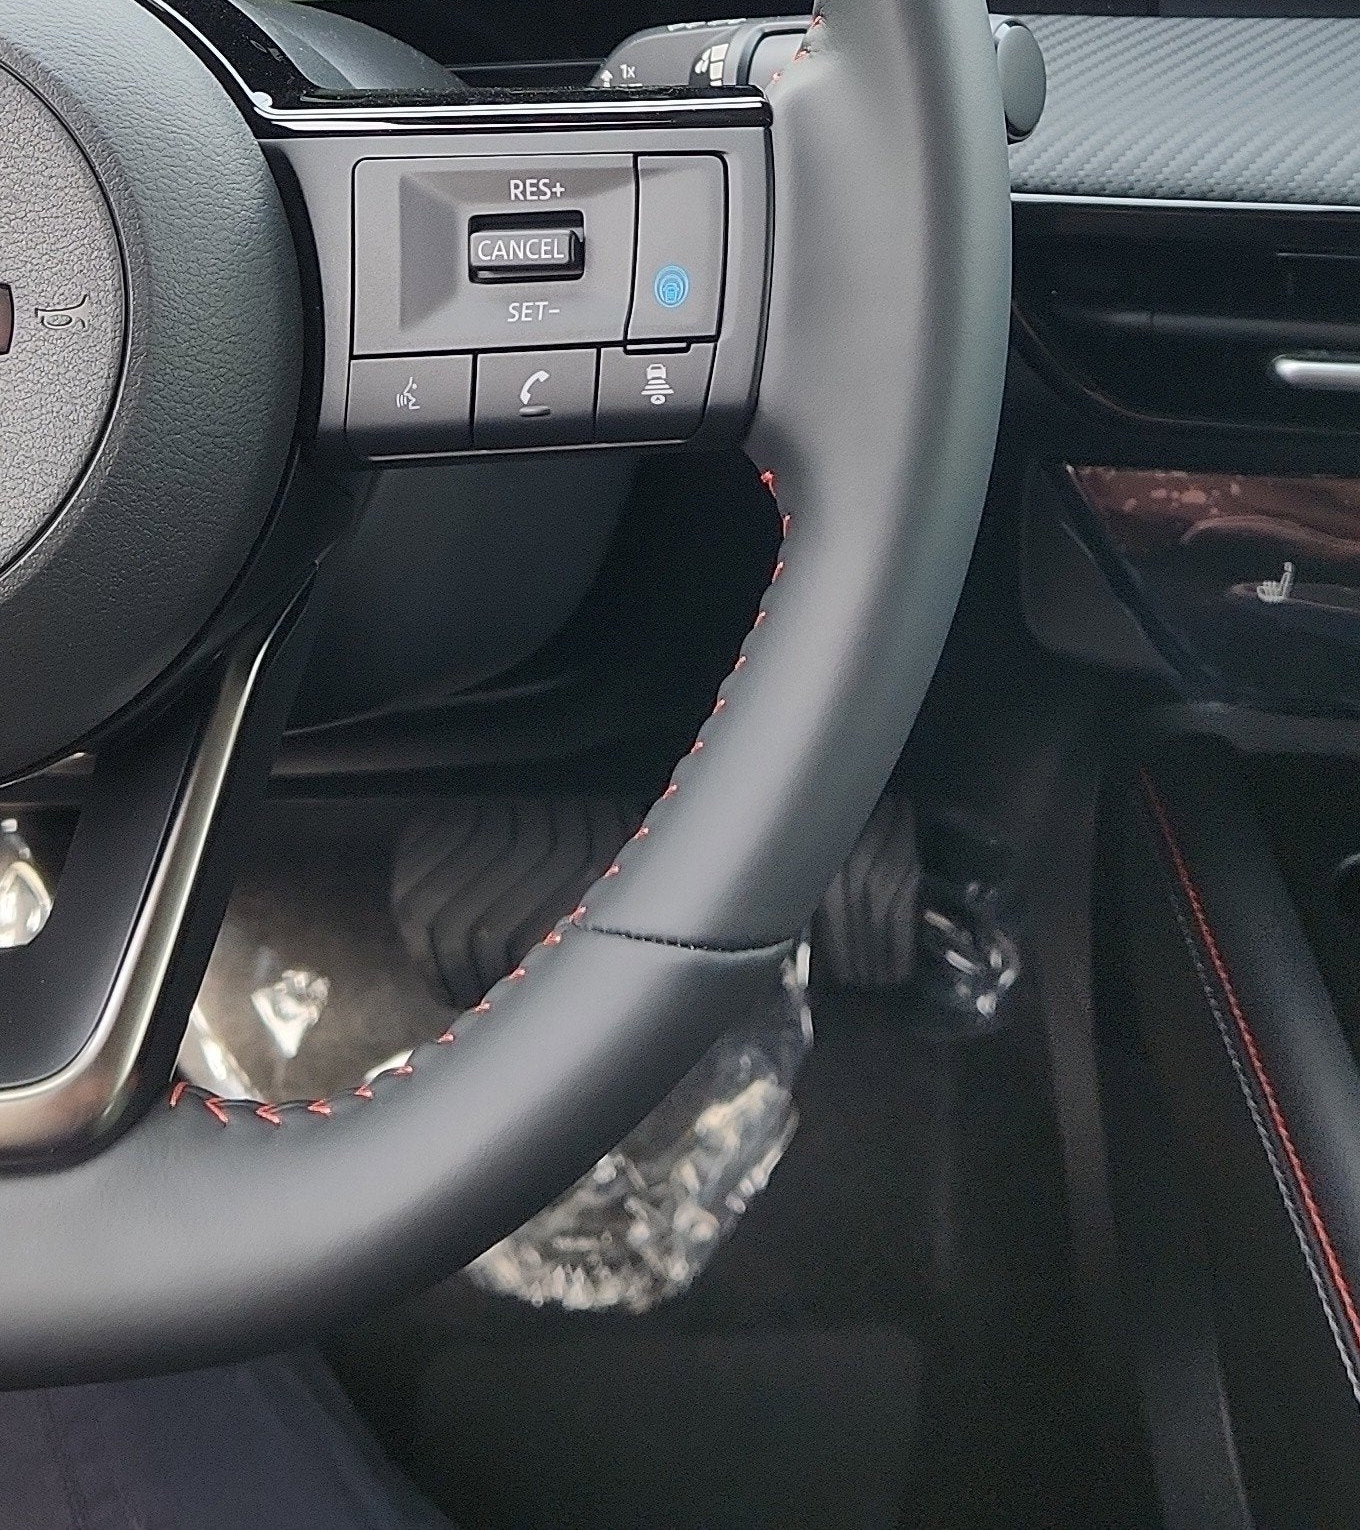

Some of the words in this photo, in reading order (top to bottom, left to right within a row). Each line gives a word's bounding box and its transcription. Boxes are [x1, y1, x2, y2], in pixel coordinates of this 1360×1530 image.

[620, 63, 636, 79] 1x
[509, 178, 566, 202] RES+
[477, 239, 565, 261] CANCEL
